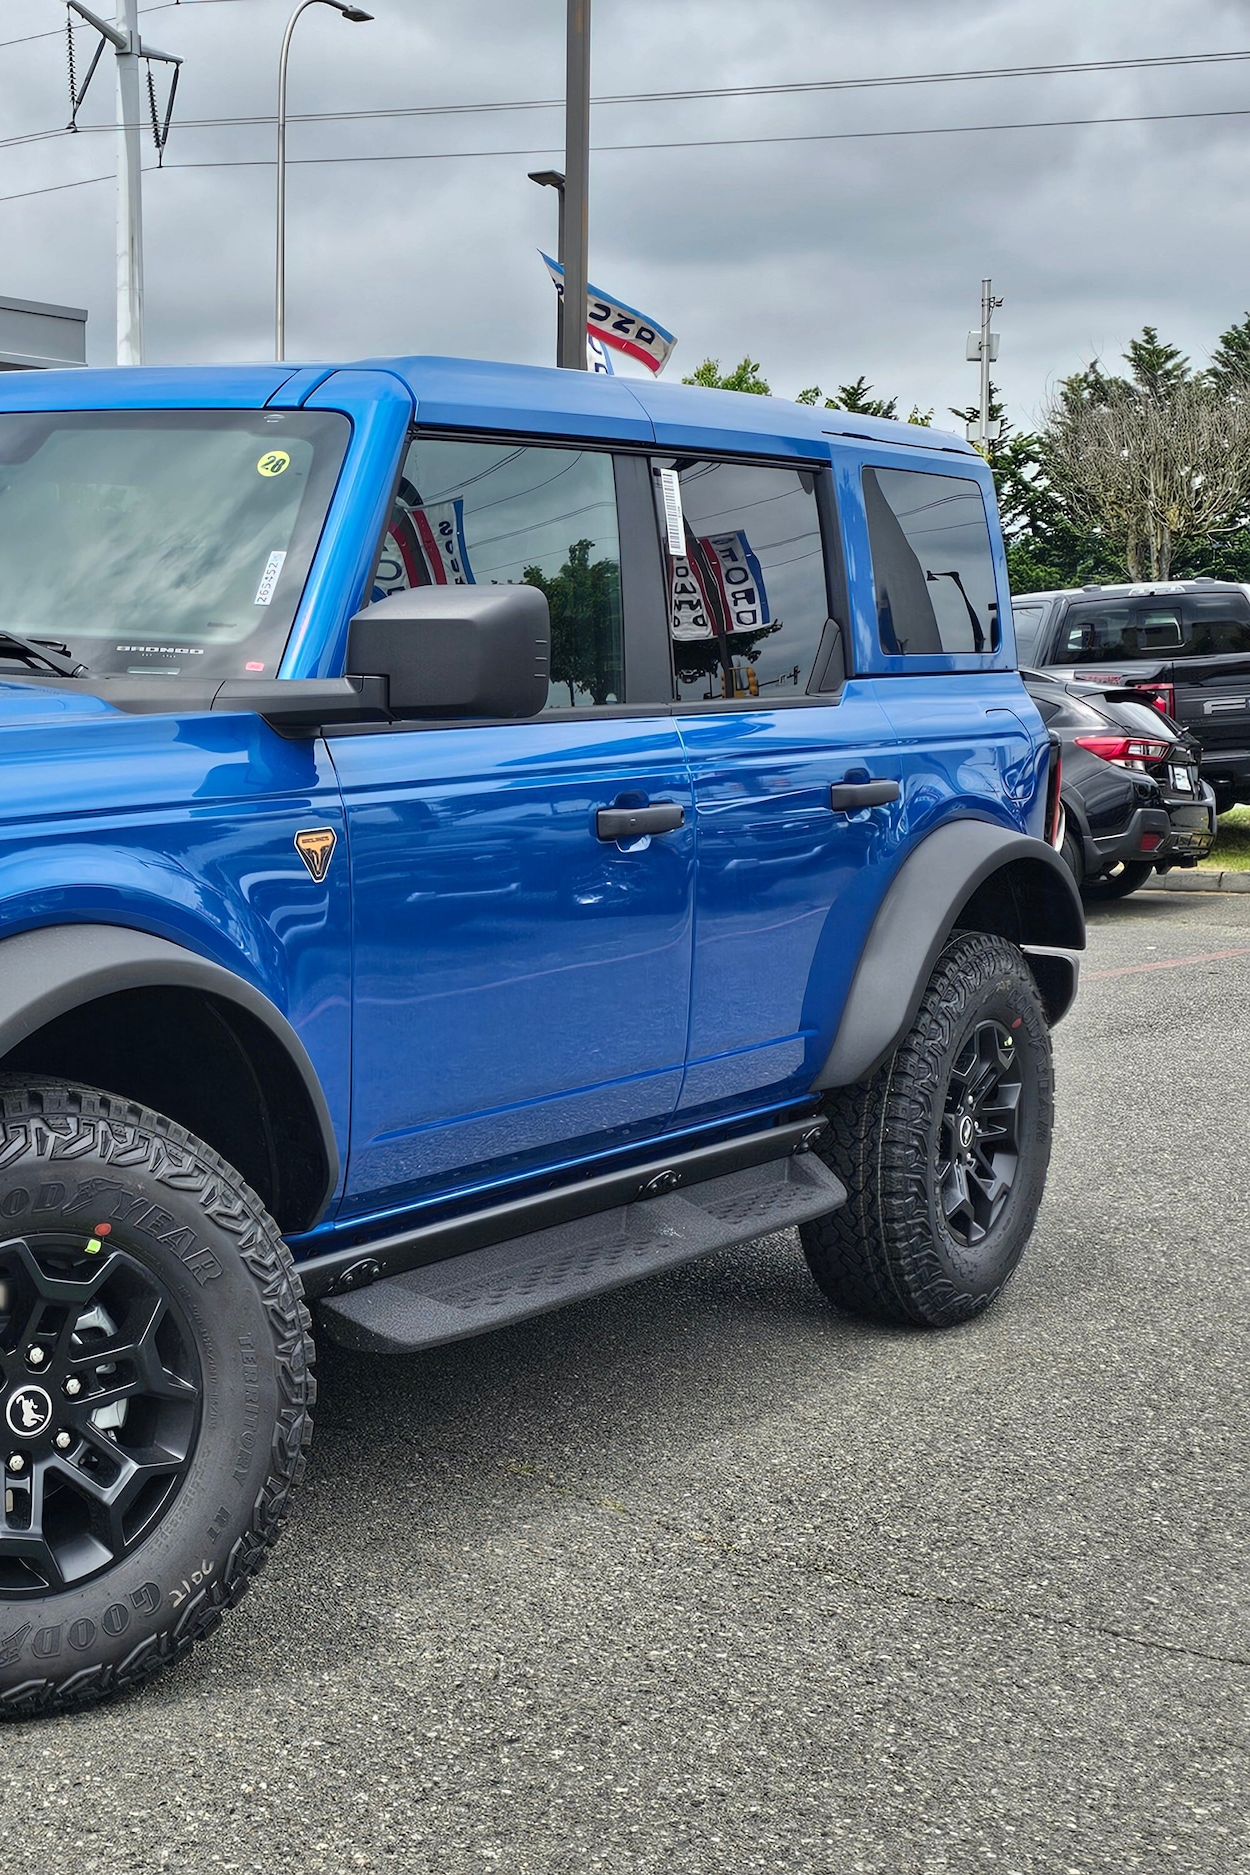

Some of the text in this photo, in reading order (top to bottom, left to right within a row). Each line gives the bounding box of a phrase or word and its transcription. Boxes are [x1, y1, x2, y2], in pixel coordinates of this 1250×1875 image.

[257, 562, 278, 603] 265452
[116, 645, 204, 655] BRONCO
[206, 1332, 259, 1545] TERRITORY RT
